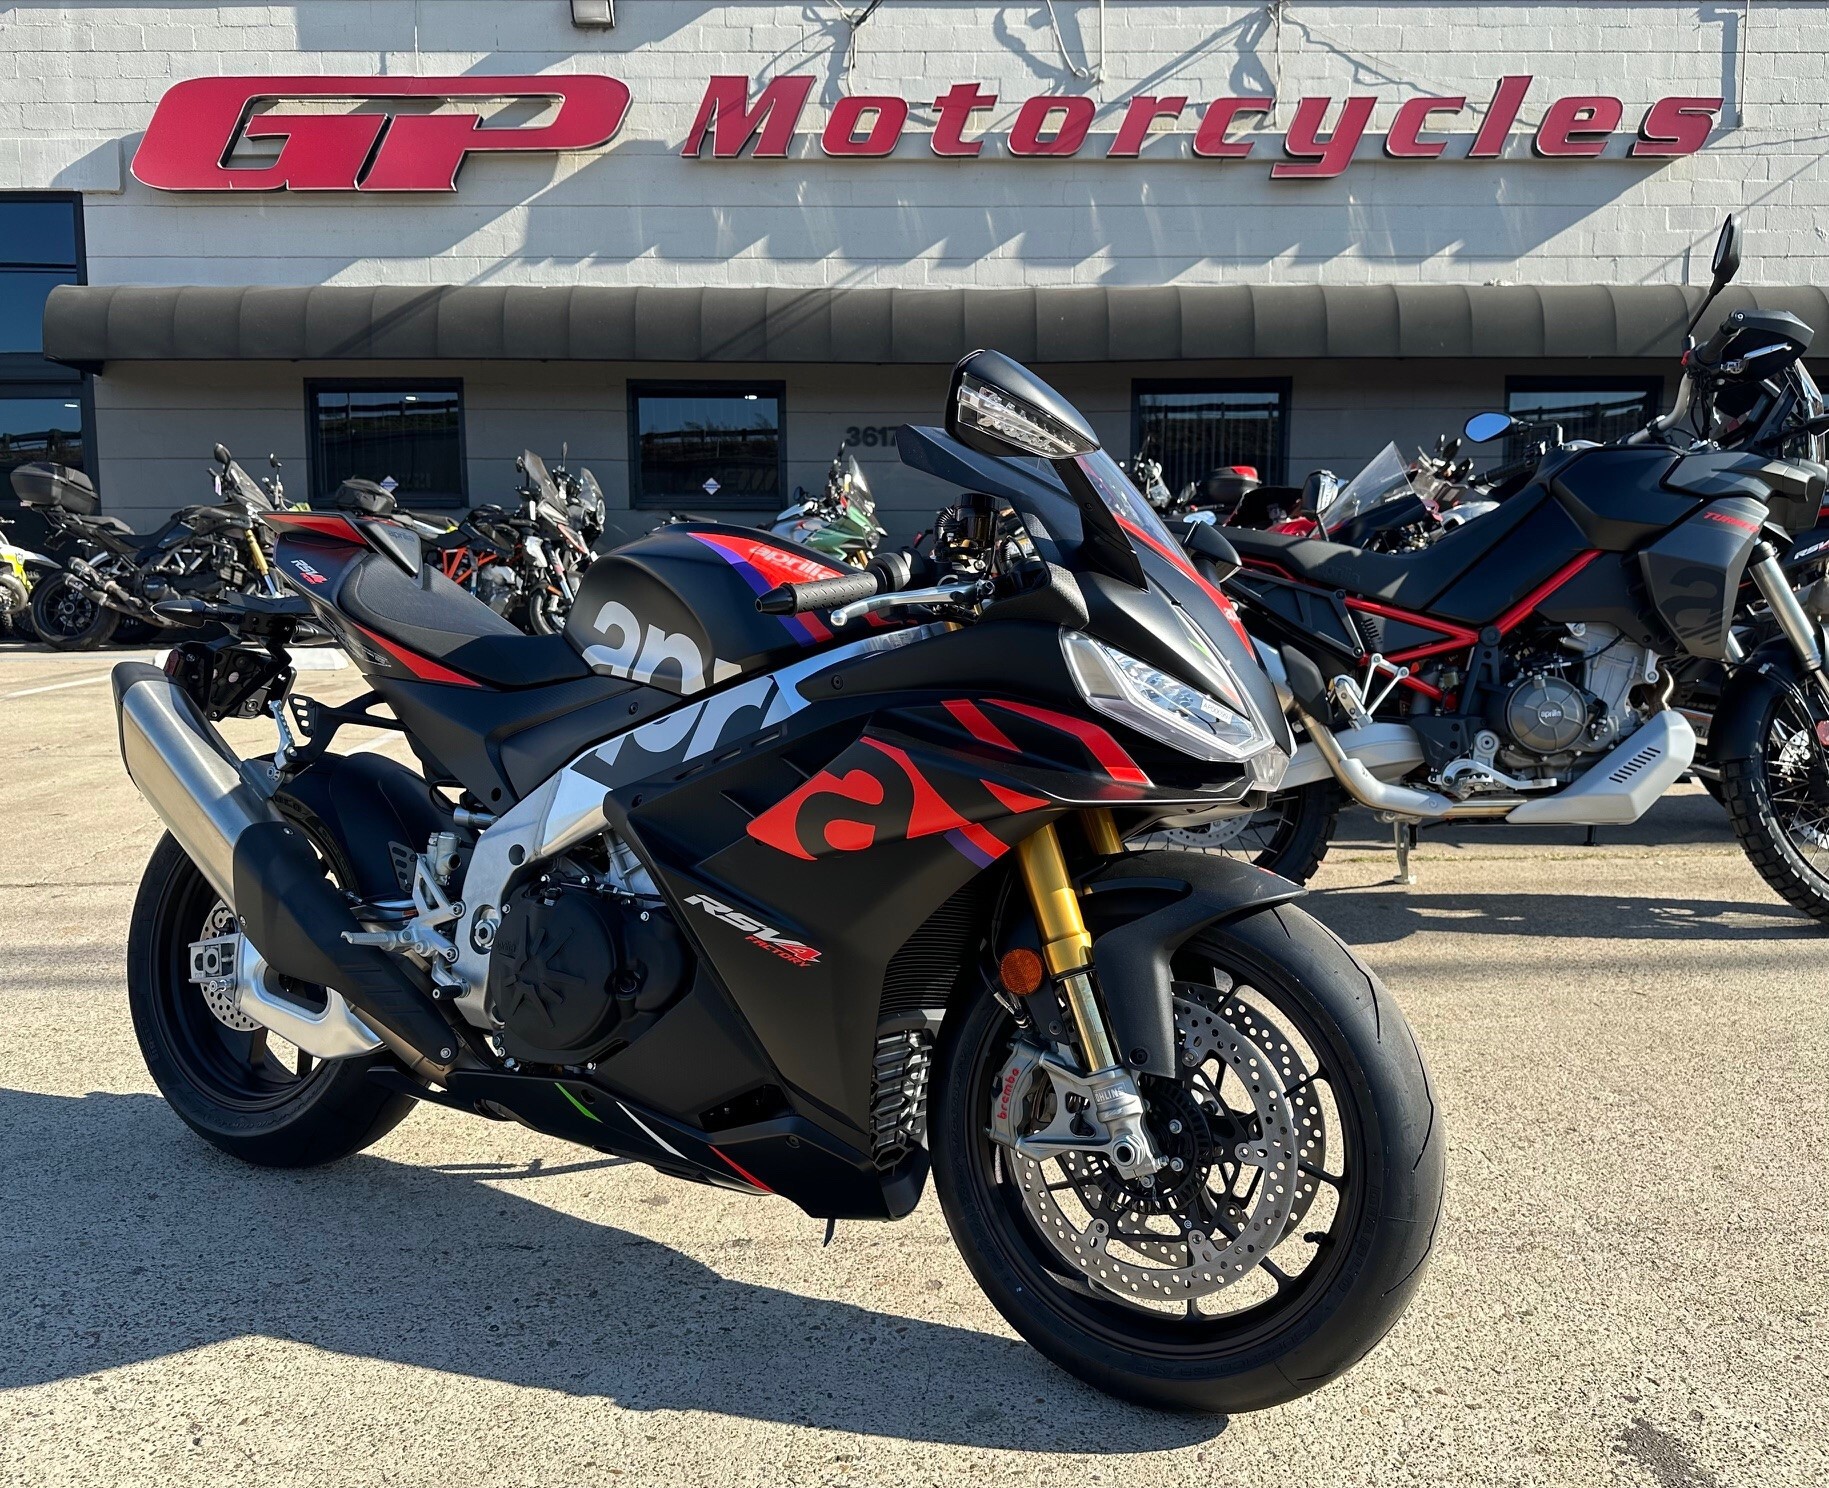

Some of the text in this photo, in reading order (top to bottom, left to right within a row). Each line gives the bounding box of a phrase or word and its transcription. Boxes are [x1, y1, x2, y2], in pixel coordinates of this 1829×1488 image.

[131, 75, 1724, 192] GP Motorcycles
[683, 894, 822, 963] RSV4
[745, 935, 811, 967] FACTORY
[997, 1067, 1020, 1120] brembo
